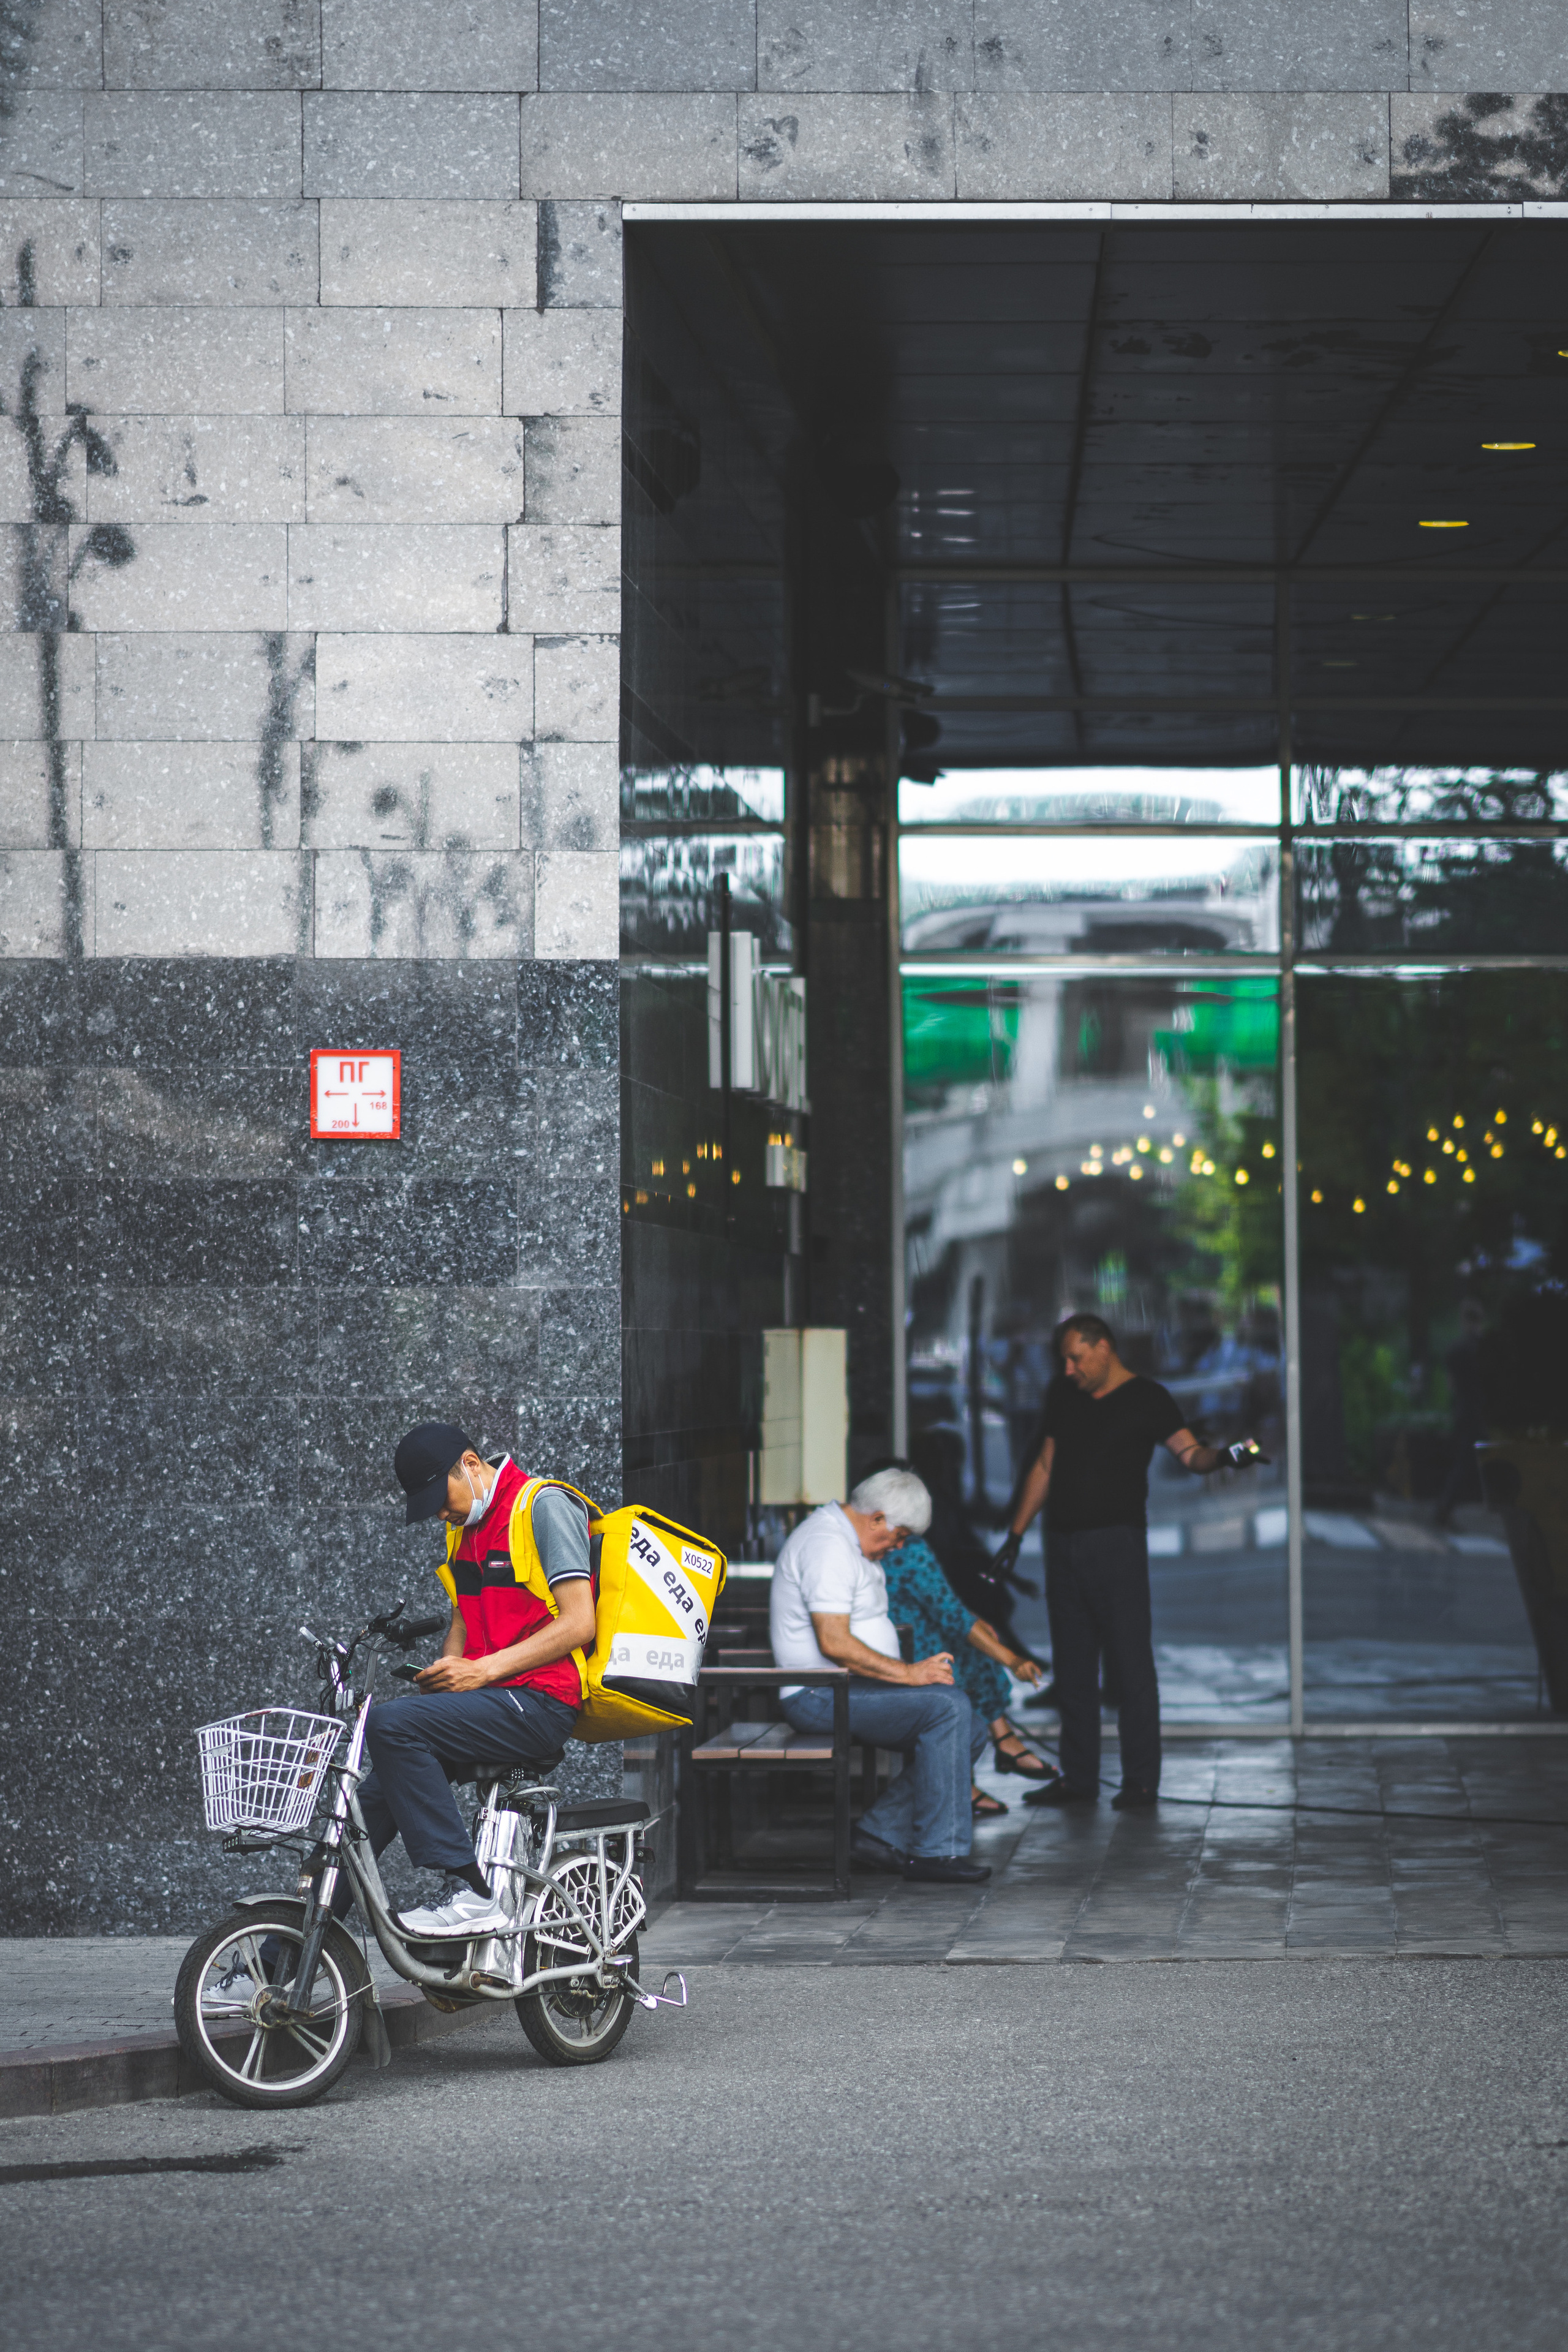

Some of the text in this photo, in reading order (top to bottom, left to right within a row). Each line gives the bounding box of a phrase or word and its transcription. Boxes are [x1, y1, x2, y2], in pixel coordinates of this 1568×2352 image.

[339, 1061, 370, 1083] ПГ
[331, 1120, 350, 1128] 200
[630, 1526, 661, 1567] еда
[663, 1571, 694, 1613] еда
[684, 1551, 712, 1574] X0522
[646, 1649, 684, 1670] еда
